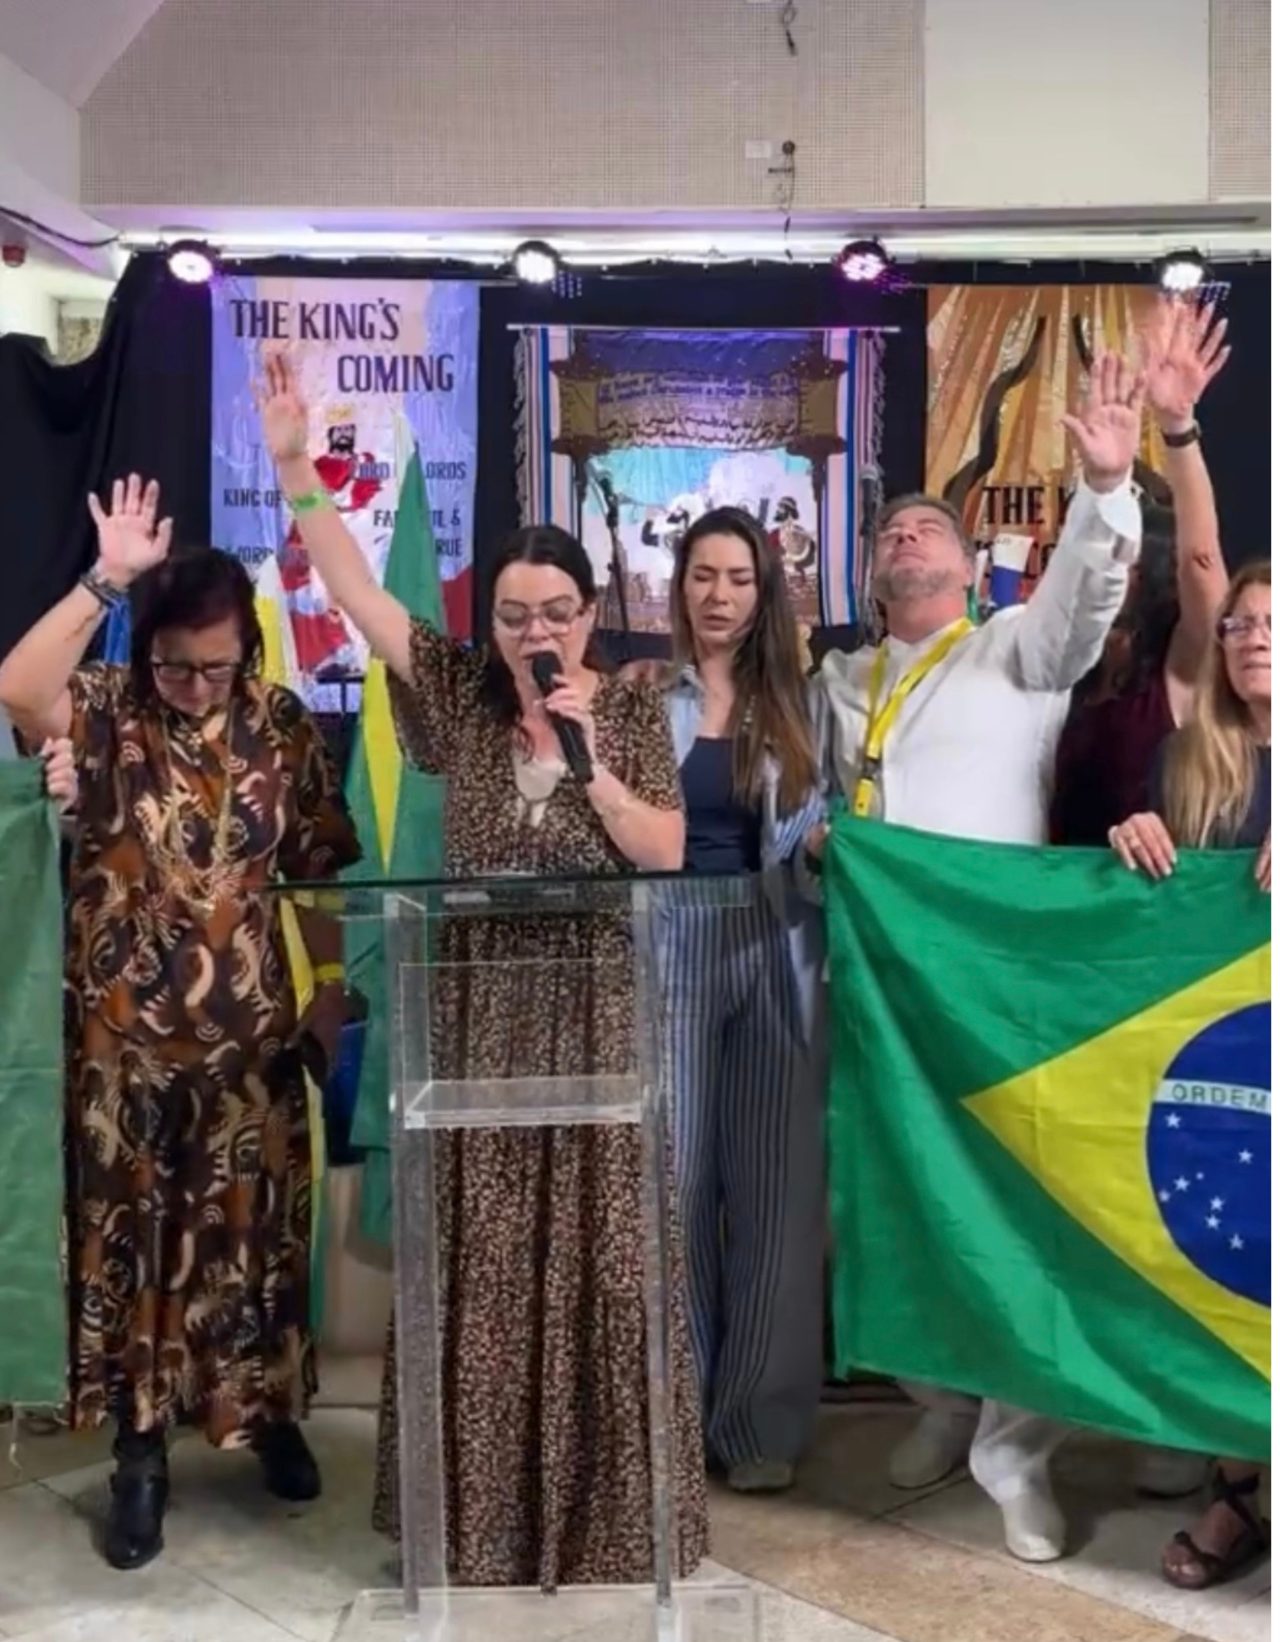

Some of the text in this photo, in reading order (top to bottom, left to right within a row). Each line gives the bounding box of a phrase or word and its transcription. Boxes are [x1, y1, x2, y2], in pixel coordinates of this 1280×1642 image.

[230, 298, 401, 340] THE KING'S
[338, 353, 455, 393] COMING
[425, 461, 467, 481] ORDS
[223, 488, 261, 508] KING
[982, 487, 1044, 524] THE
[435, 539, 462, 557] RUE
[1171, 1083, 1268, 1110] ORDEM
